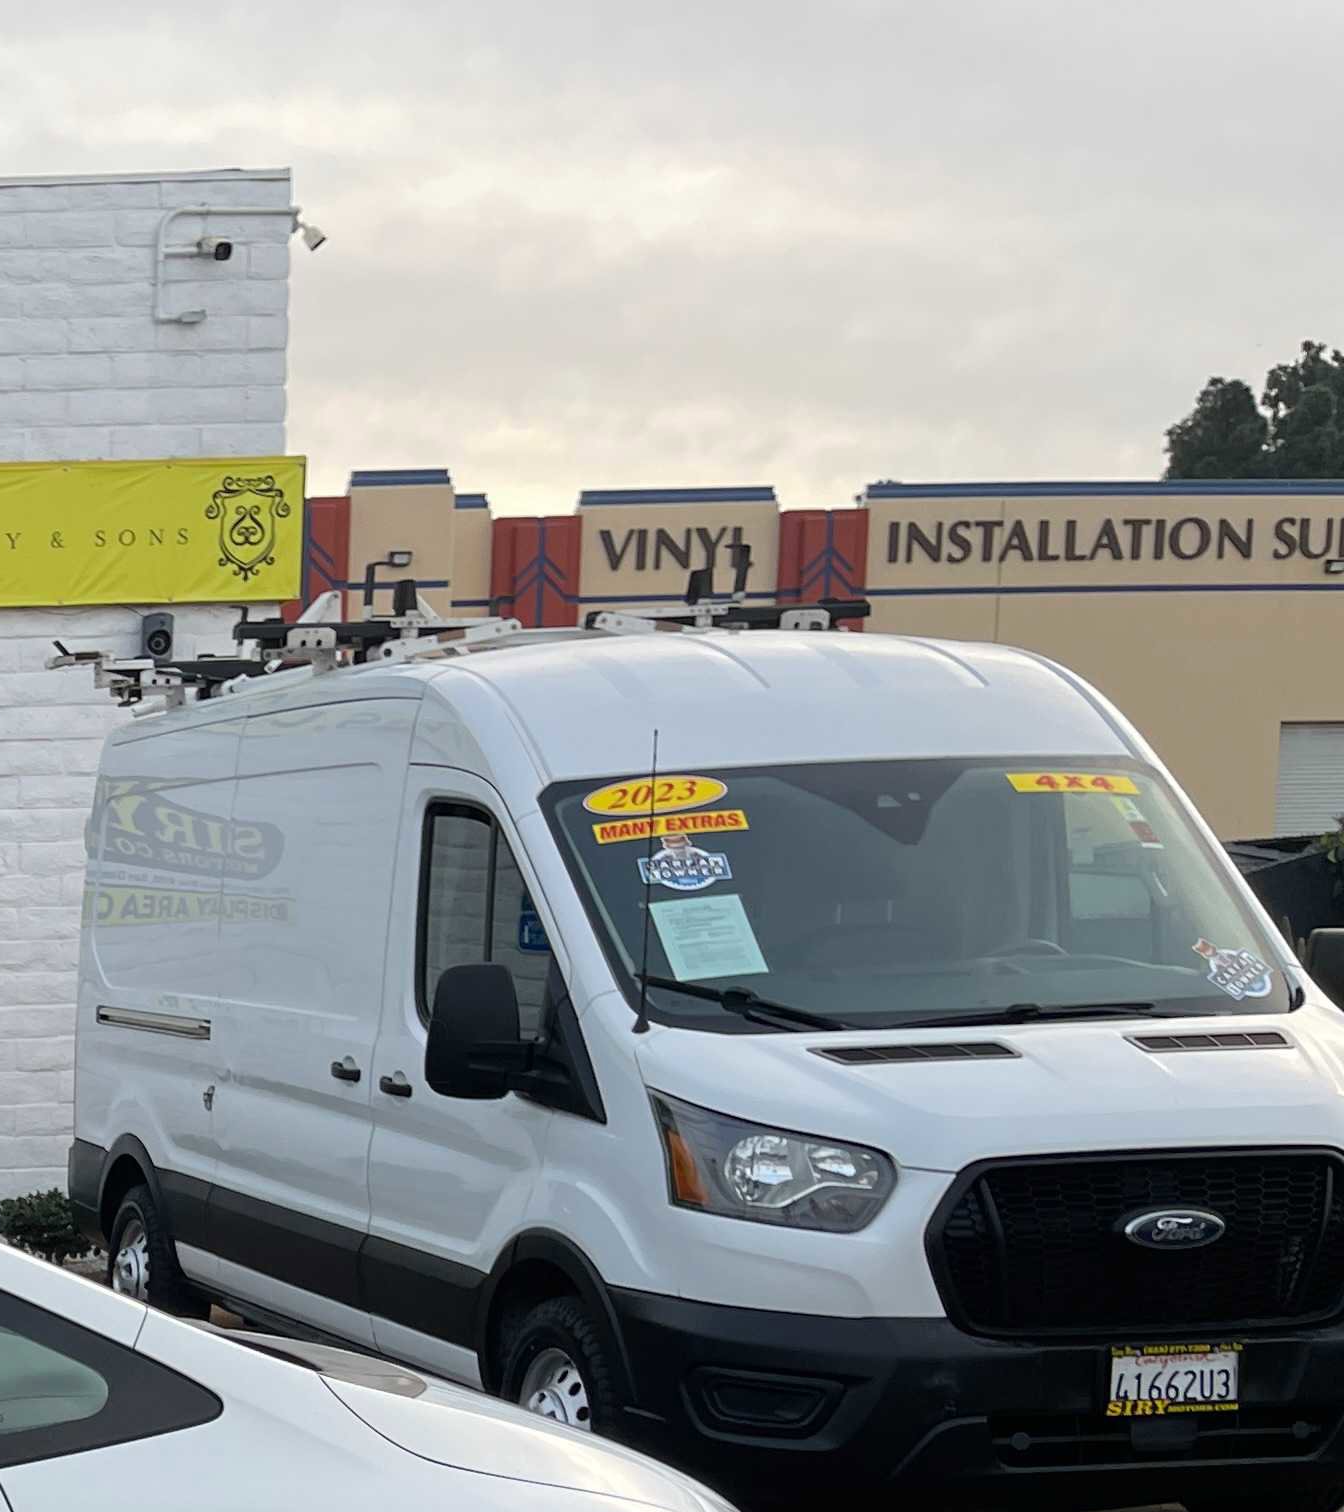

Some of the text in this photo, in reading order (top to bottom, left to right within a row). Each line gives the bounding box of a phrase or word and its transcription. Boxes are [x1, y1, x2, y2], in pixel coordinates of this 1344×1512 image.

[50, 531, 64, 548] &
[94, 528, 189, 547] SONS
[888, 516, 1254, 564] INSTALLATION
[608, 780, 698, 810] 2023
[599, 813, 743, 841] MANY EXTRAS
[1116, 1369, 1230, 1401] 41662U3
[1106, 1400, 1168, 1416] SIRY
